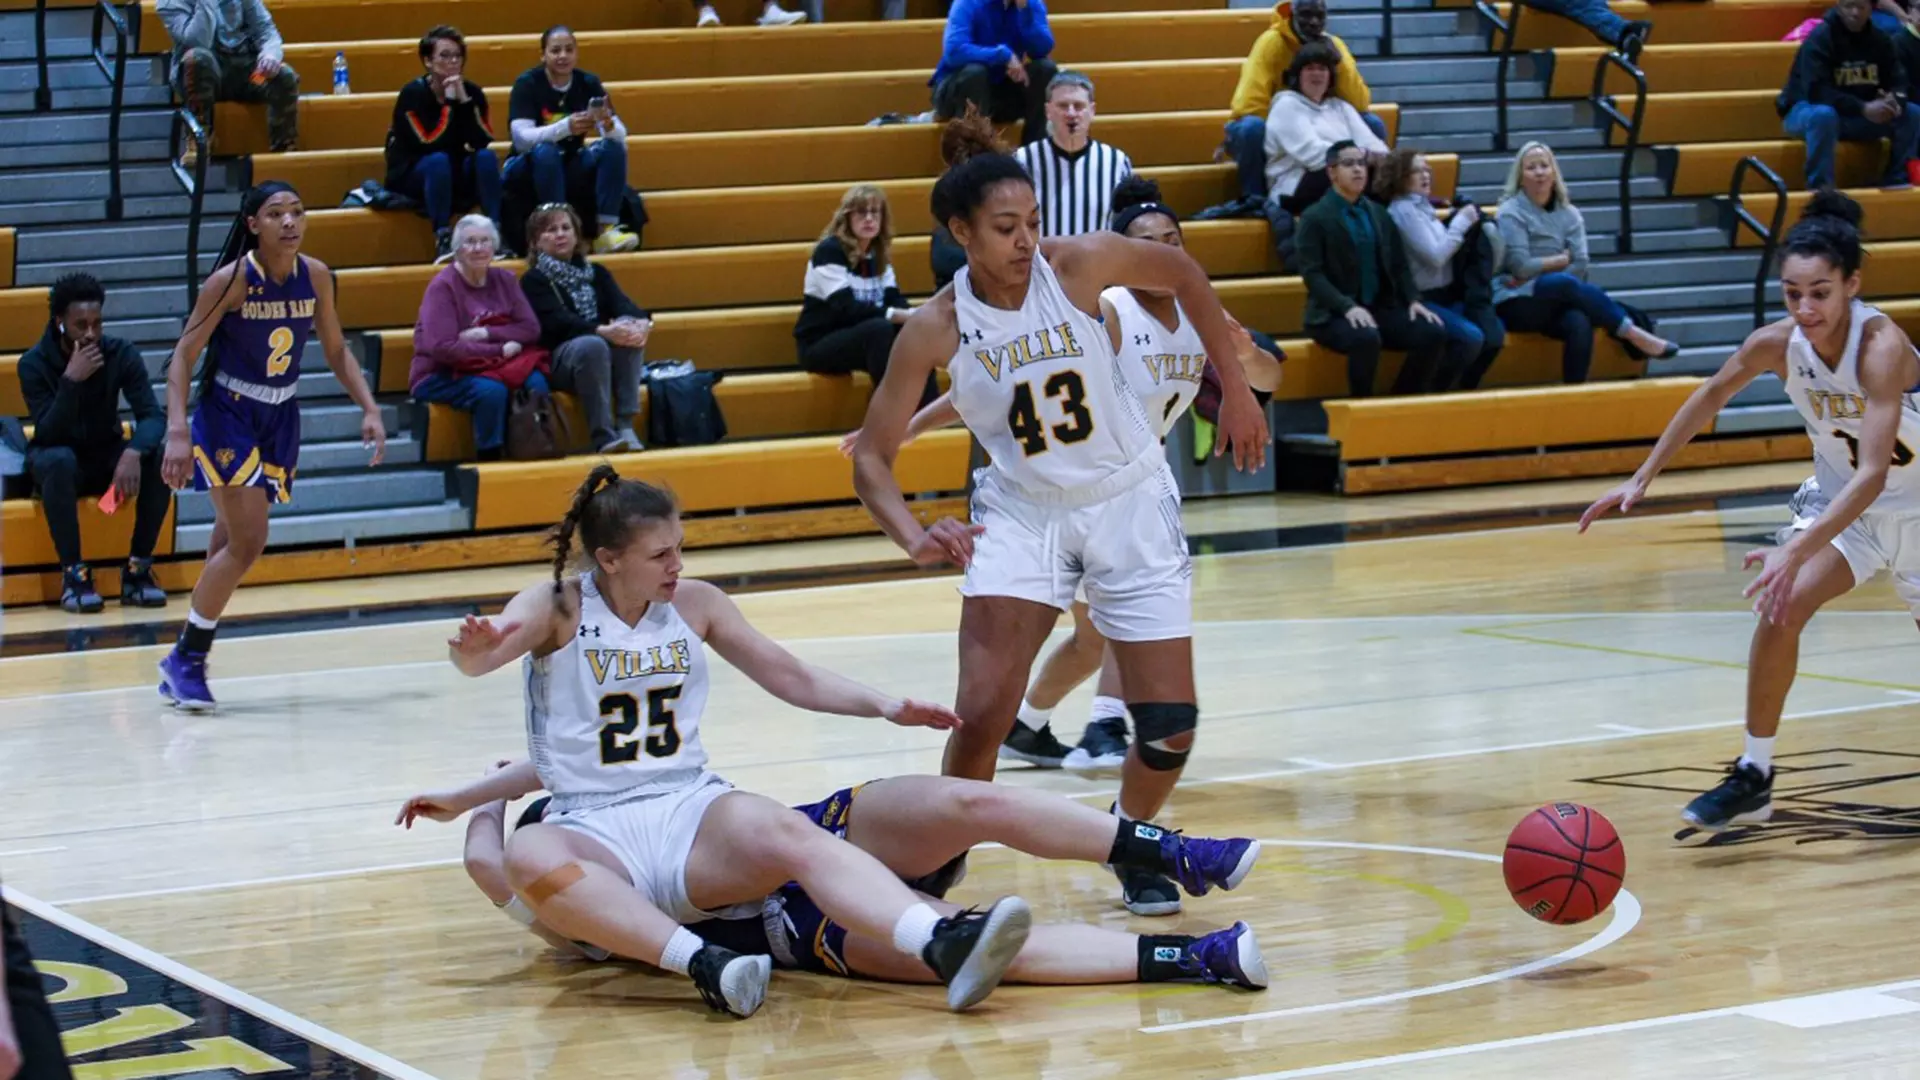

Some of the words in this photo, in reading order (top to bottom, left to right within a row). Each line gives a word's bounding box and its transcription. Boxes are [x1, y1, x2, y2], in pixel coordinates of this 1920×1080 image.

[266, 325, 295, 378] 2
[974, 321, 1084, 383] VILLE
[1007, 367, 1095, 459] 43
[584, 638, 691, 685] VILLE
[597, 683, 684, 766] 25
